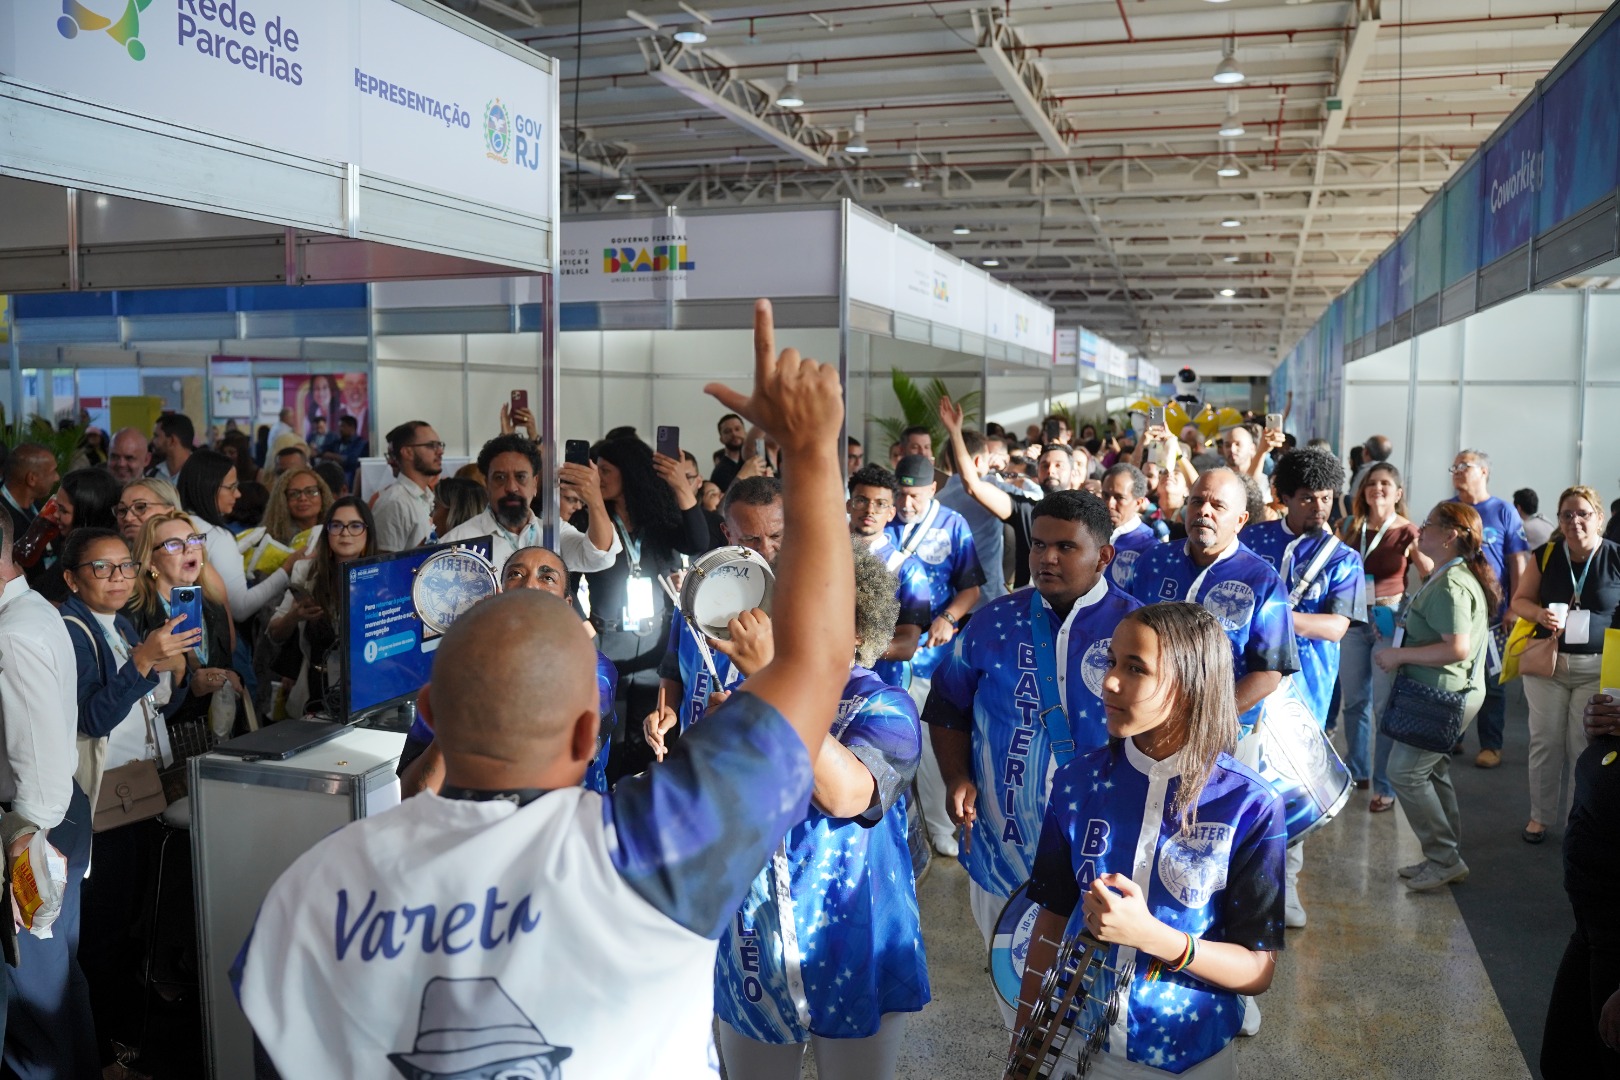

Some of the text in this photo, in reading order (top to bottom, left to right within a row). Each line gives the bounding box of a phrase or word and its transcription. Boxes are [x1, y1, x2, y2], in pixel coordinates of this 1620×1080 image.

[178, 12, 303, 86] Parcerias
[265, 16, 299, 52] de
[515, 115, 542, 141] GOV
[515, 135, 539, 170] RJ
[611, 236, 649, 244] GOVERNO
[603, 245, 695, 273] BRASIL
[1217, 581, 1252, 596] BATERIA
[1219, 616, 1237, 629] RUC
[1002, 643, 1040, 846] BATERIA
[334, 886, 542, 962] Vareta
